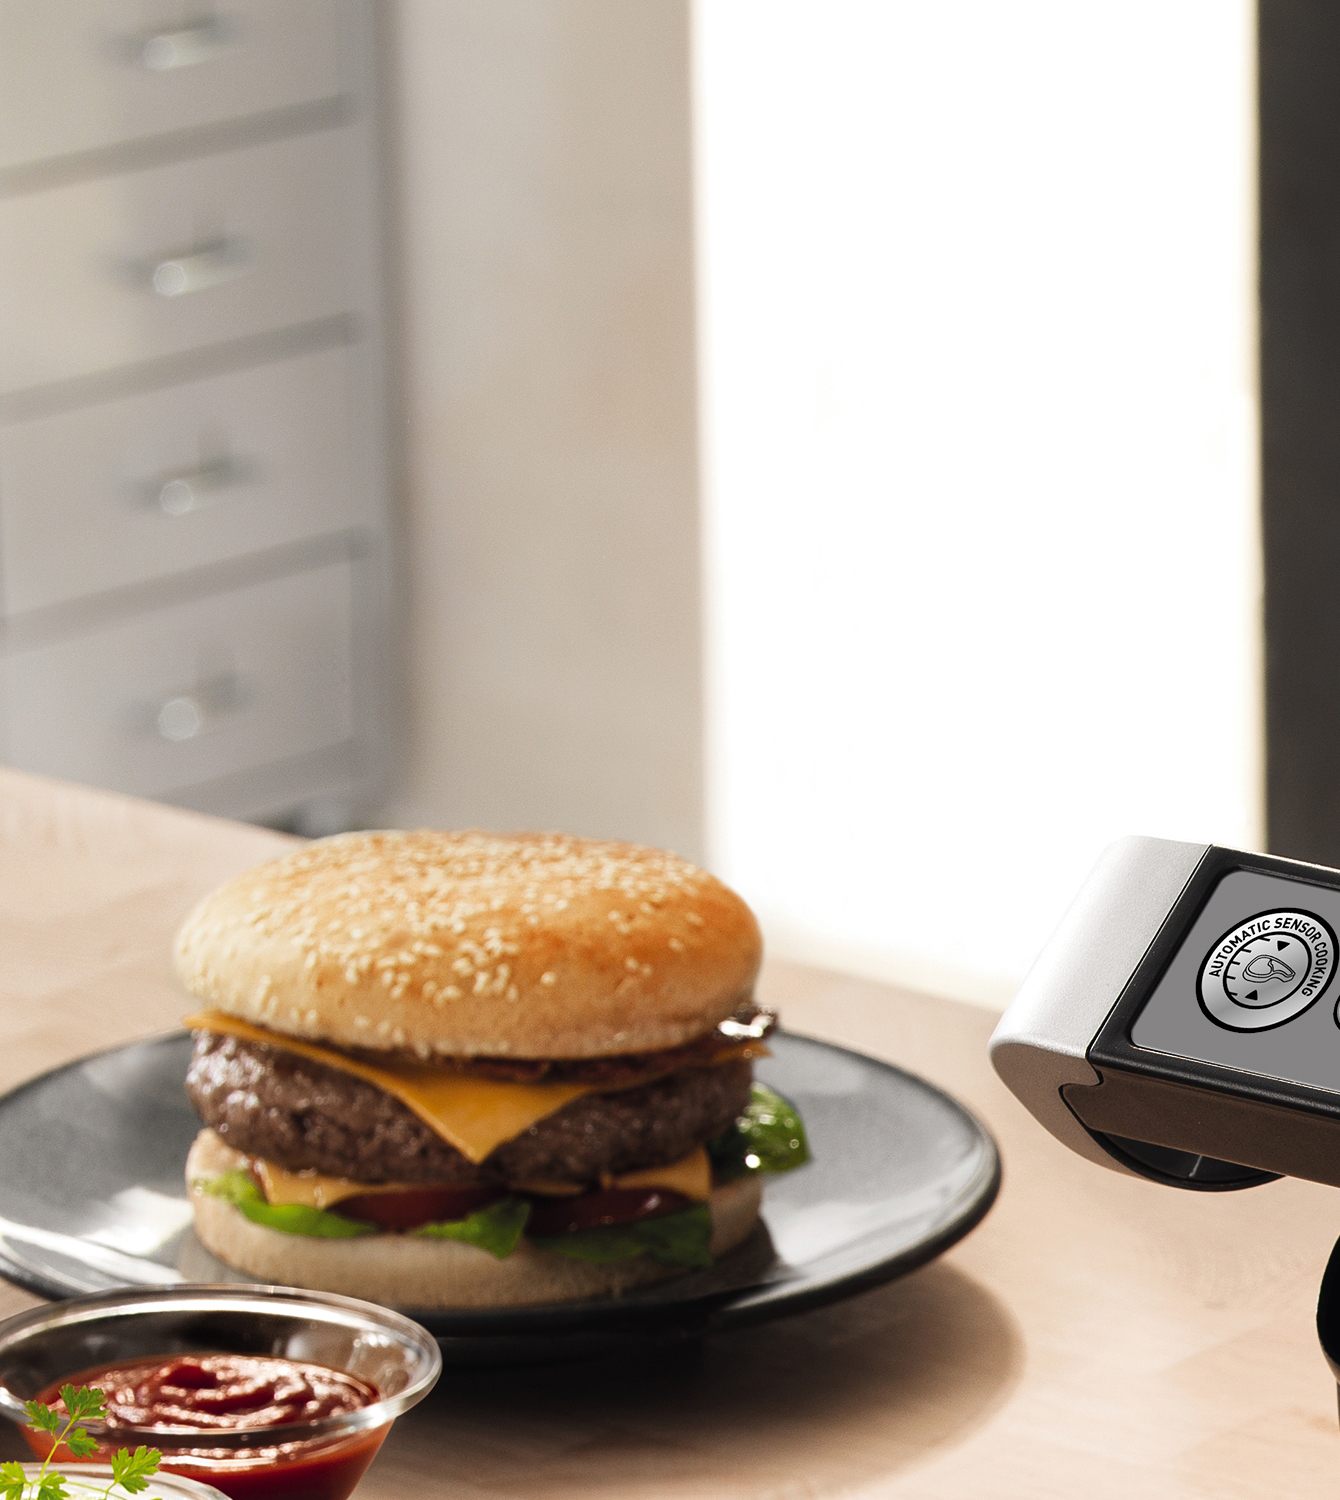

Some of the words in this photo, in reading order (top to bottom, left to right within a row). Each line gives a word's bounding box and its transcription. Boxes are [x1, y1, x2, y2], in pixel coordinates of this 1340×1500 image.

[1208, 920, 1271, 977] AUTOMATIC
[1274, 917, 1322, 944] SENSOR
[1301, 941, 1328, 997] COOKING
